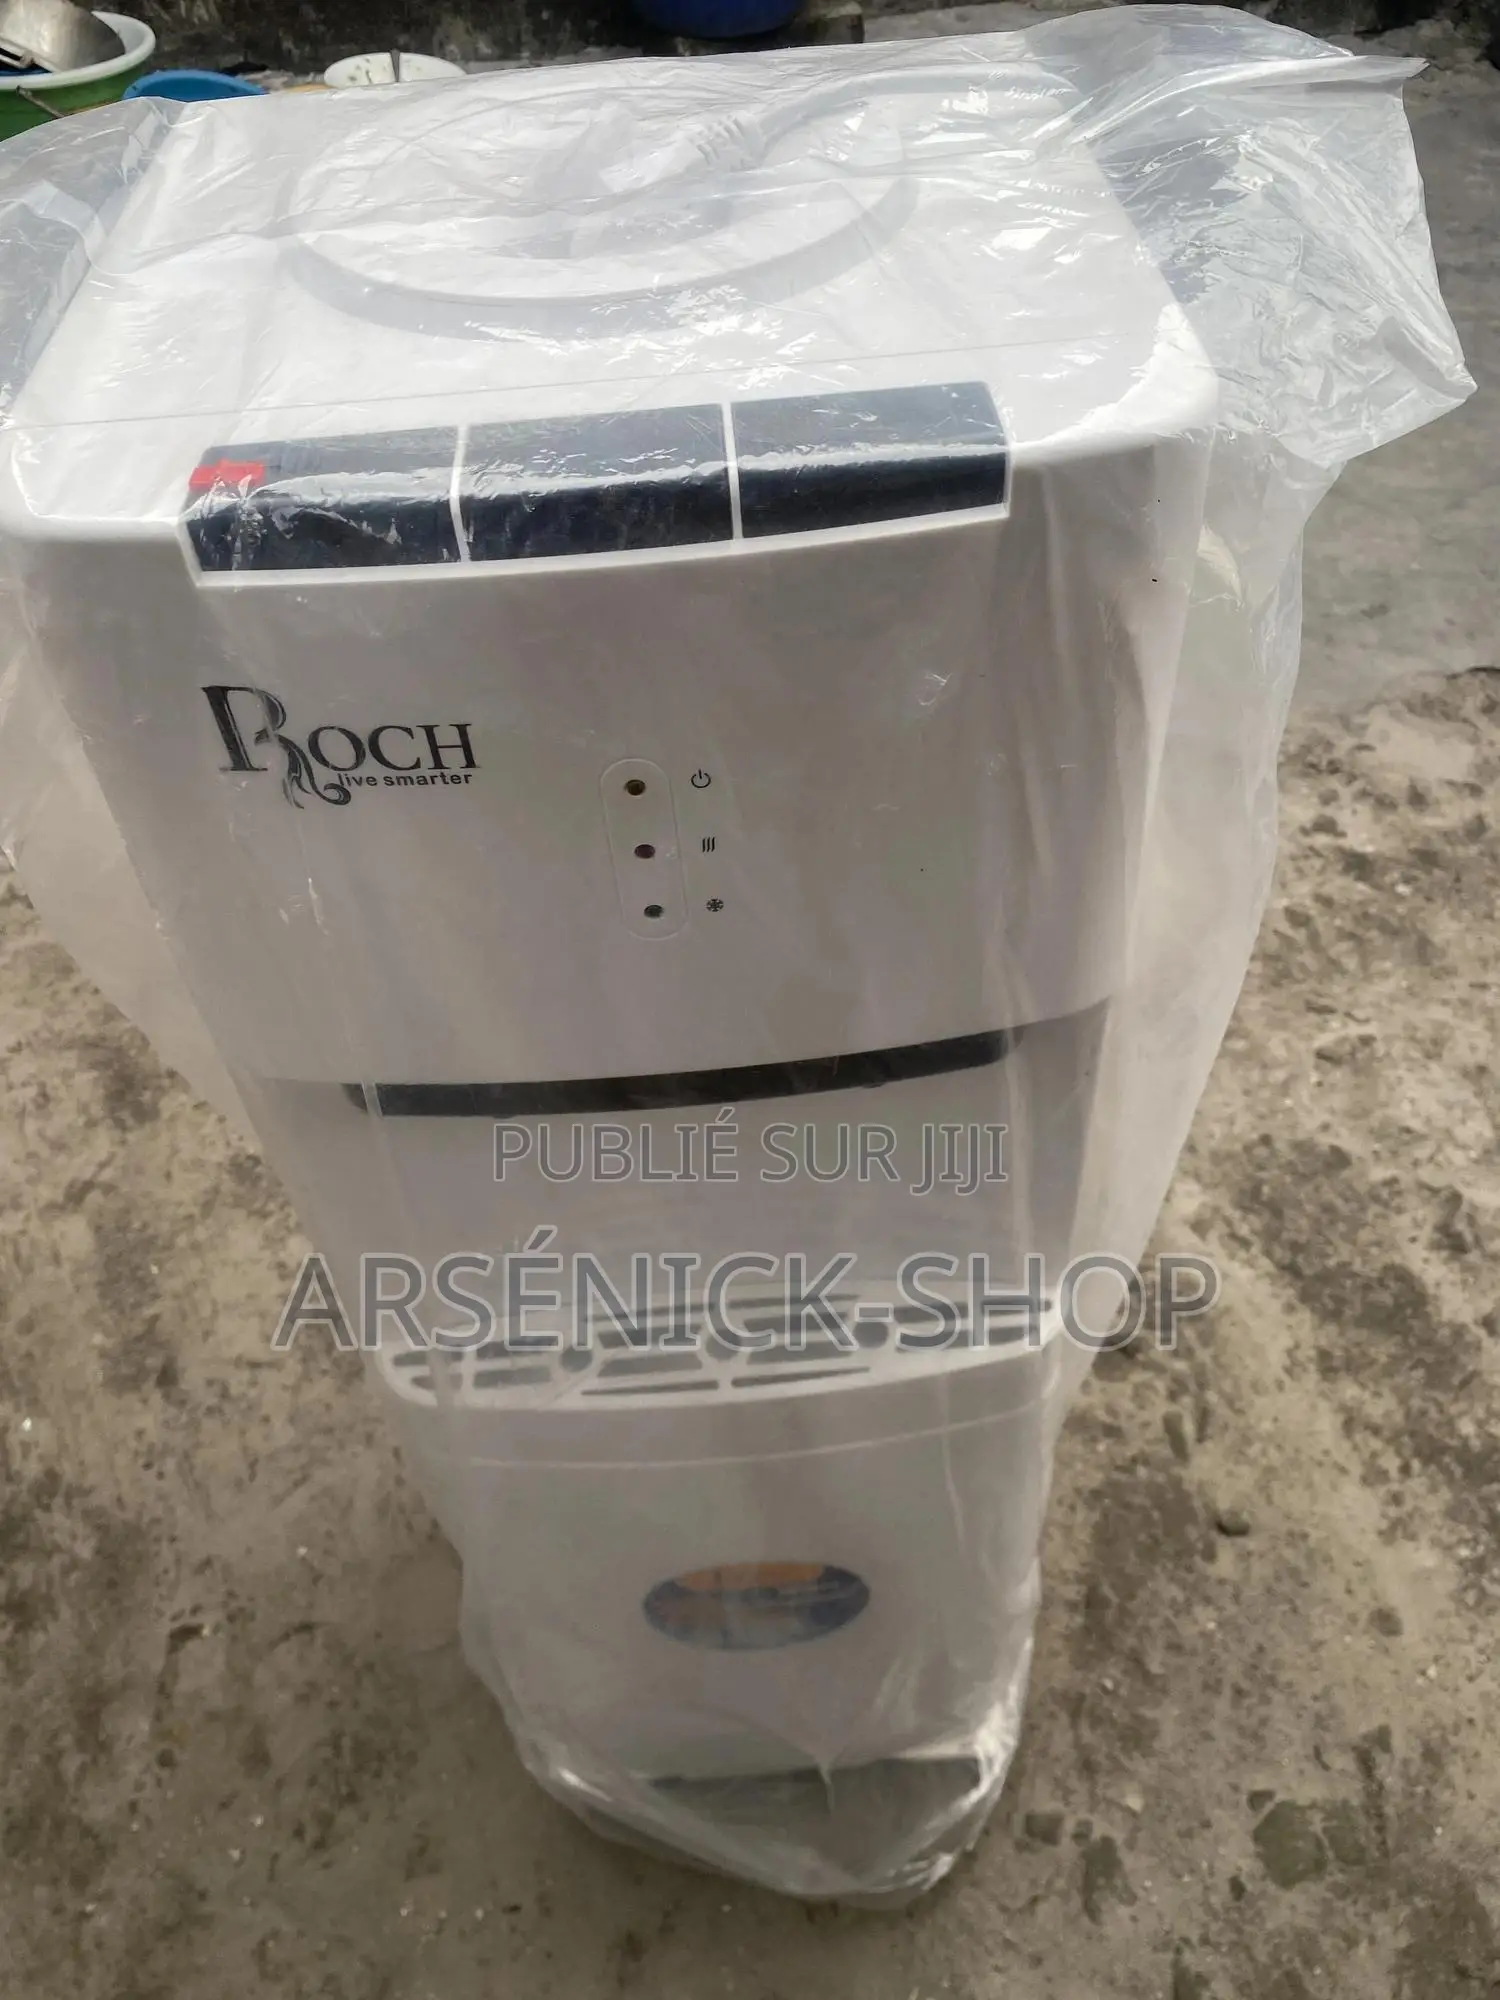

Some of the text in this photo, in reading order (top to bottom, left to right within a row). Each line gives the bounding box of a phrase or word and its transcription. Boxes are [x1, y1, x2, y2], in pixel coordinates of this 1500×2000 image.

[201, 685, 481, 809] ROCH
[338, 772, 473, 787] live smarter
